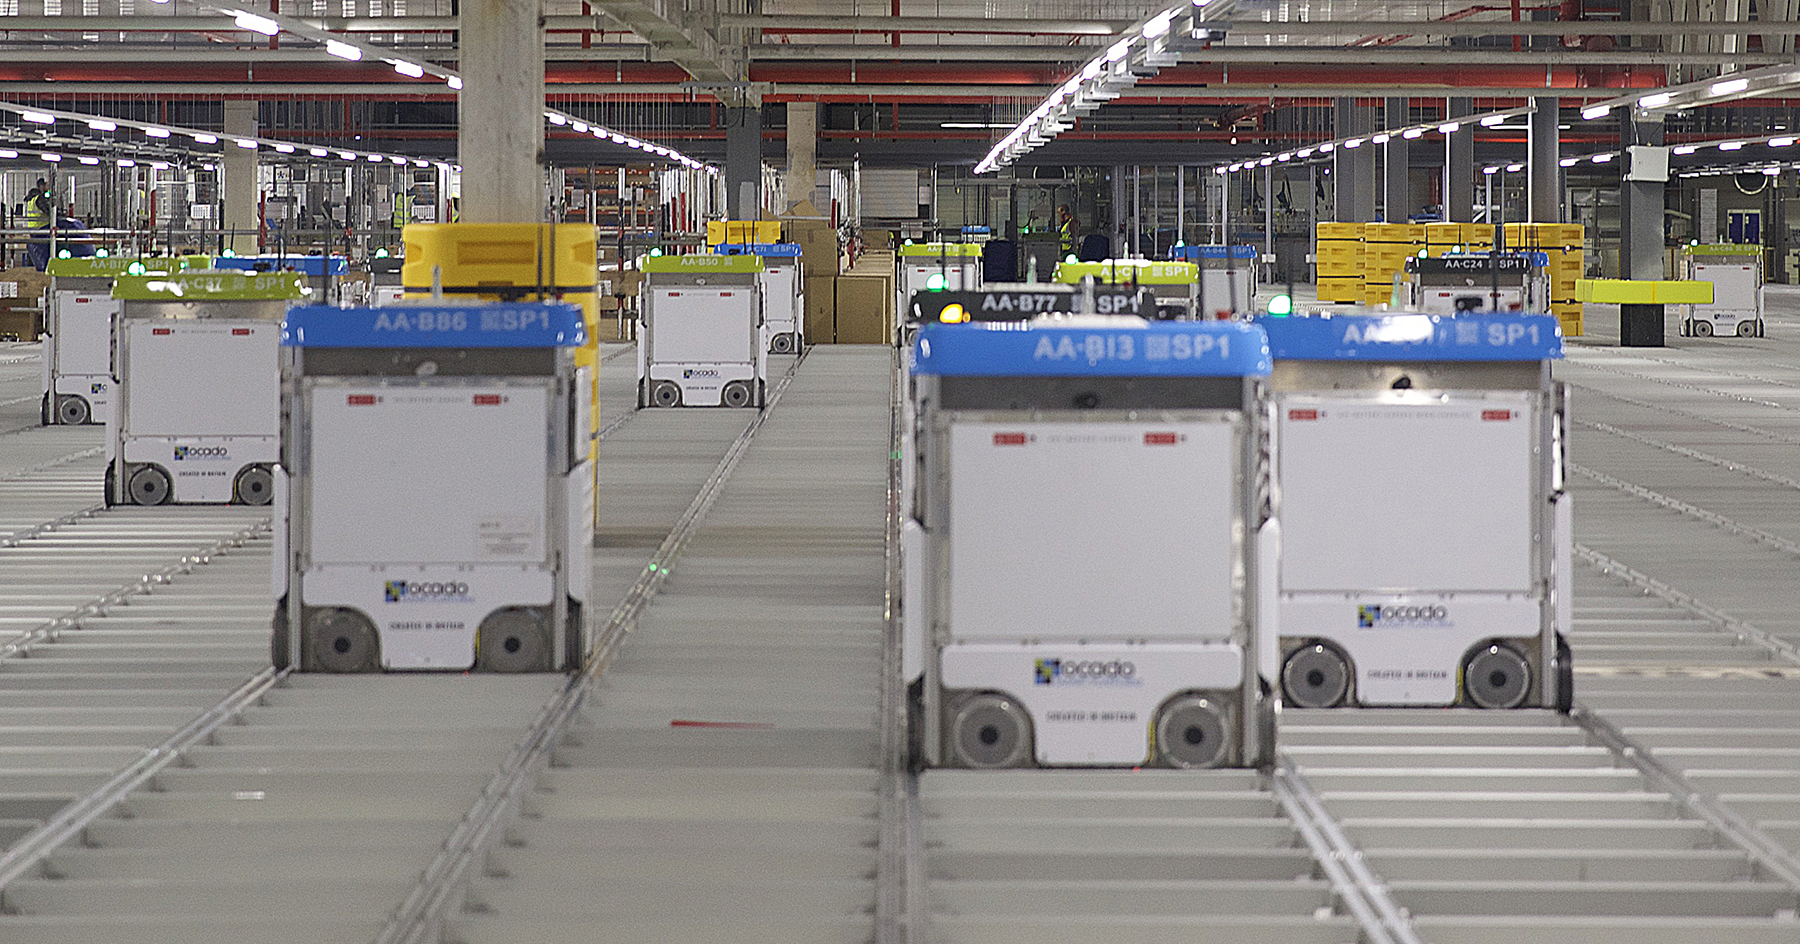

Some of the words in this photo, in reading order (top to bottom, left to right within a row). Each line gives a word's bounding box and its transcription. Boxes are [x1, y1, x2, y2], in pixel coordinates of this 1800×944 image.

[1165, 266, 1189, 277] SP1
[1499, 259, 1519, 269] SP1
[255, 277, 285, 290] SP1
[1097, 295, 1139, 313] SP1
[502, 310, 549, 331] SP1
[1487, 323, 1539, 347] SP1
[1172, 333, 1230, 360] SP1
[189, 446, 228, 457] ocado
[408, 580, 470, 596] ocado
[1382, 604, 1448, 622] ocado
[1062, 658, 1137, 680] ocado
